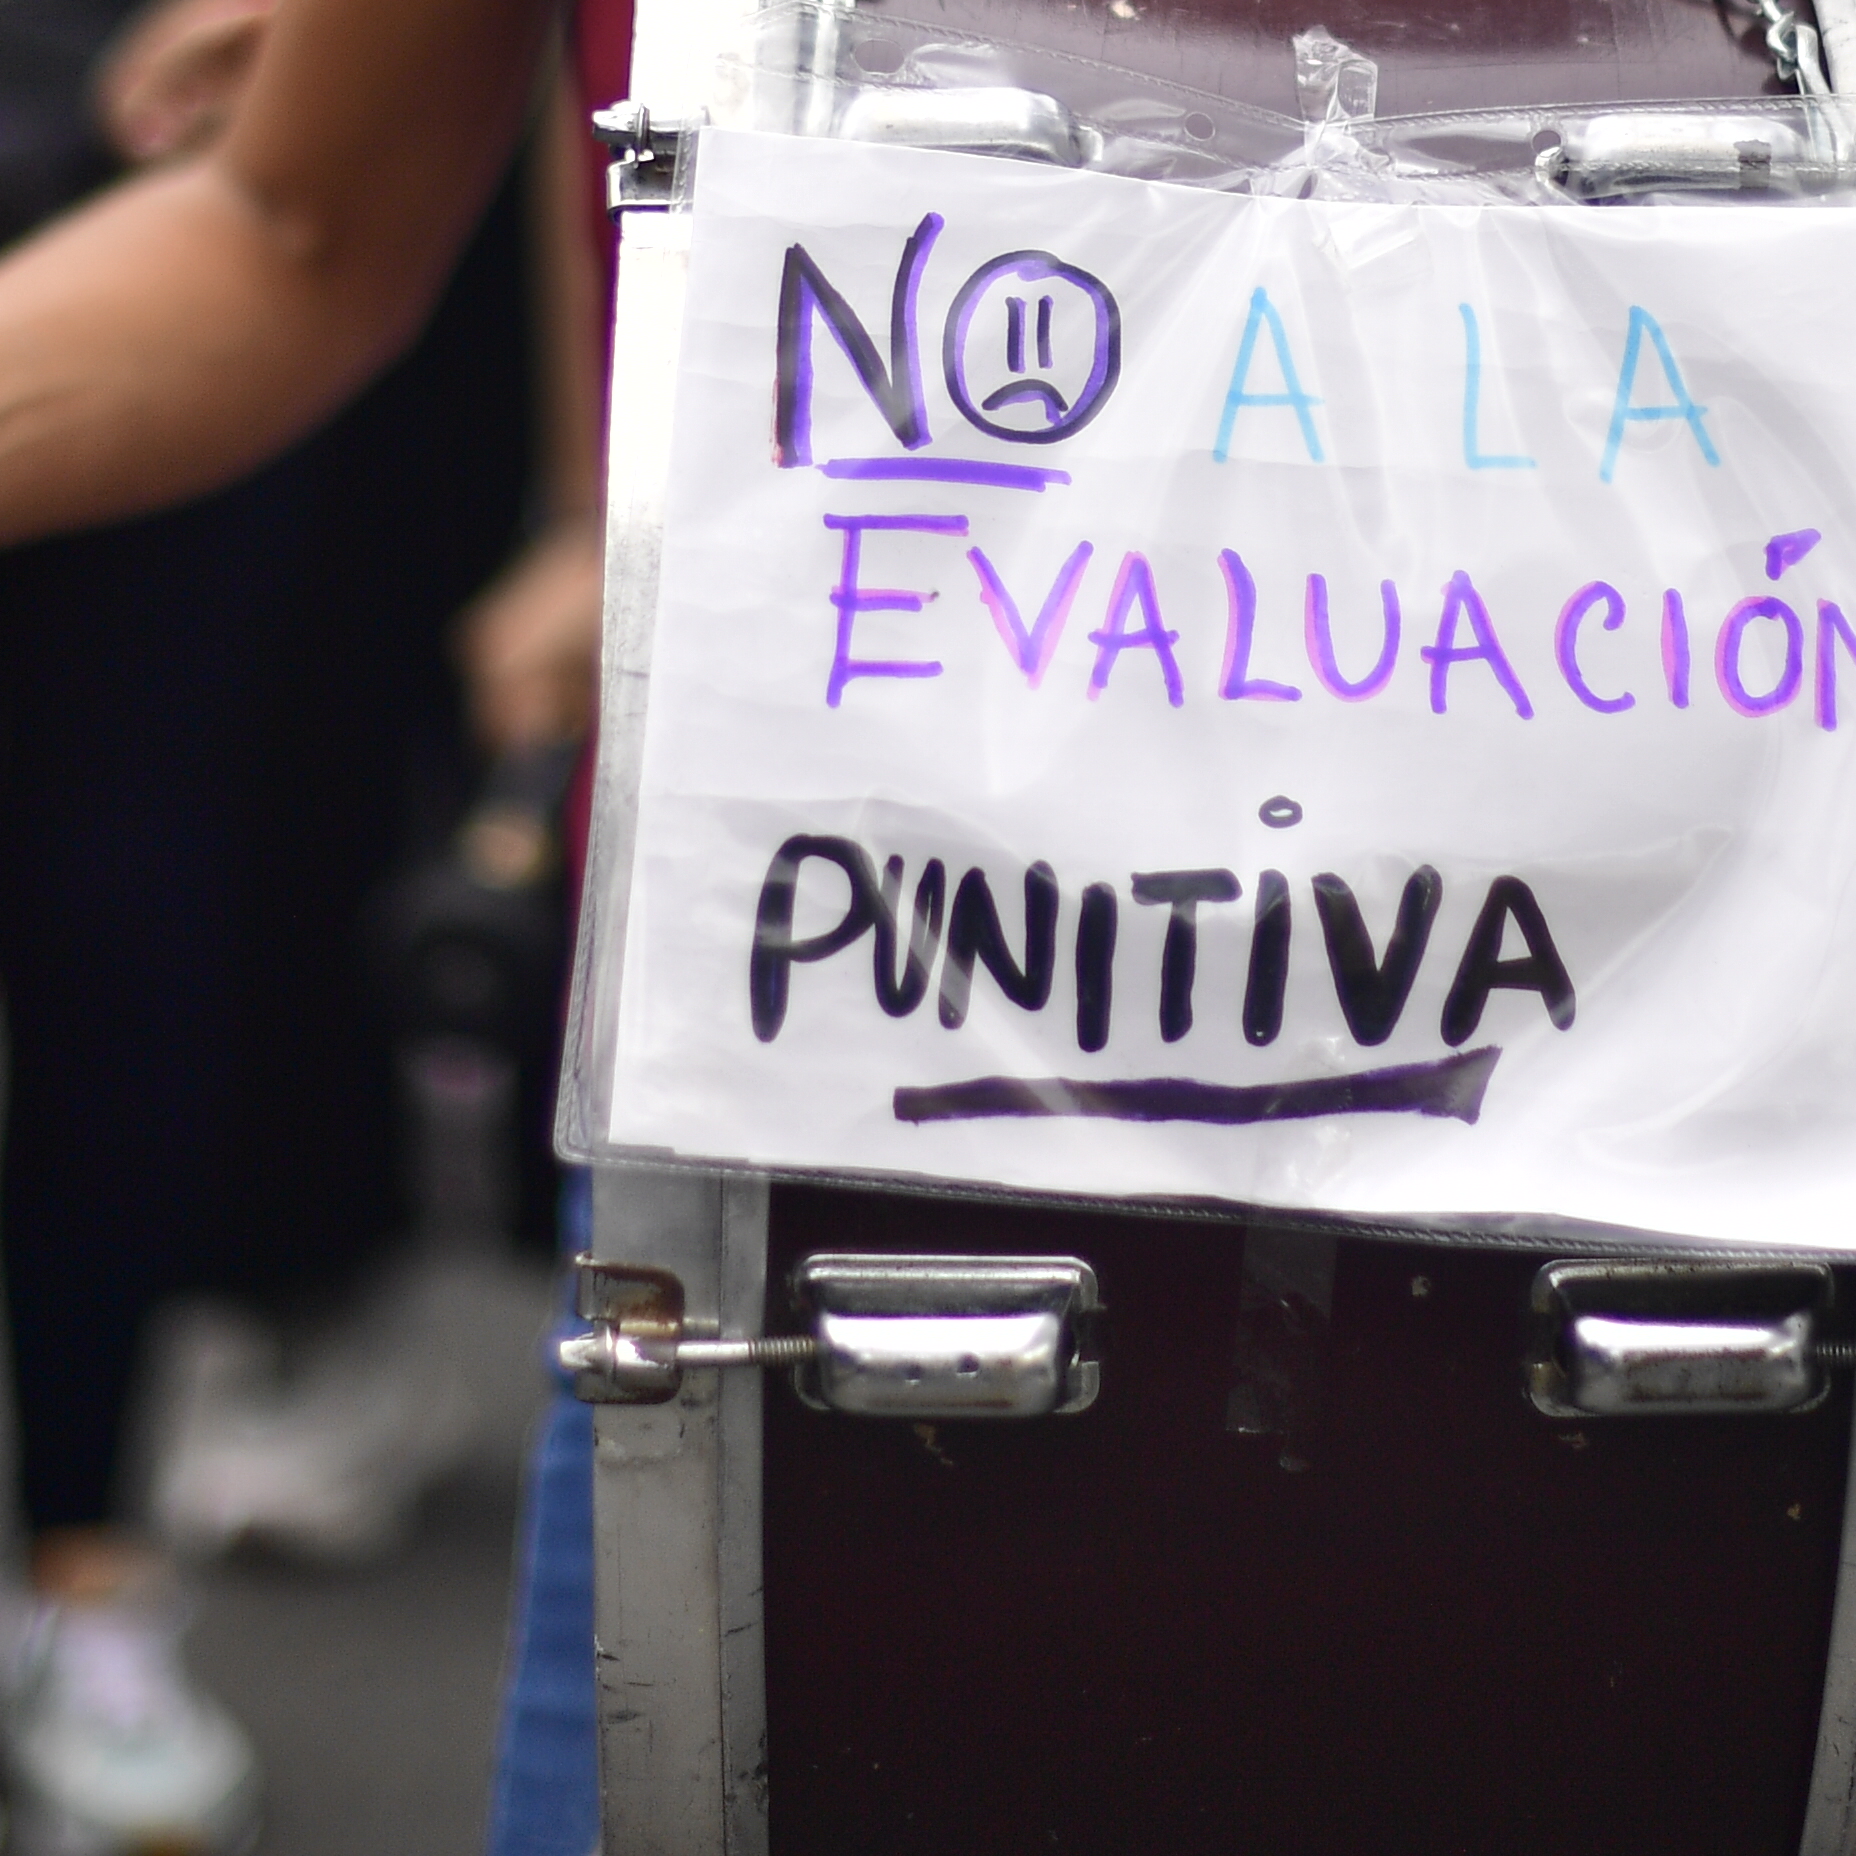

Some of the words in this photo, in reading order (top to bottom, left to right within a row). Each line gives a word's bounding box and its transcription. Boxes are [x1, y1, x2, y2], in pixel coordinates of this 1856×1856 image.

[773, 212, 1121, 467] NO
[1213, 287, 1325, 464] A
[1459, 302, 1724, 482] LA
